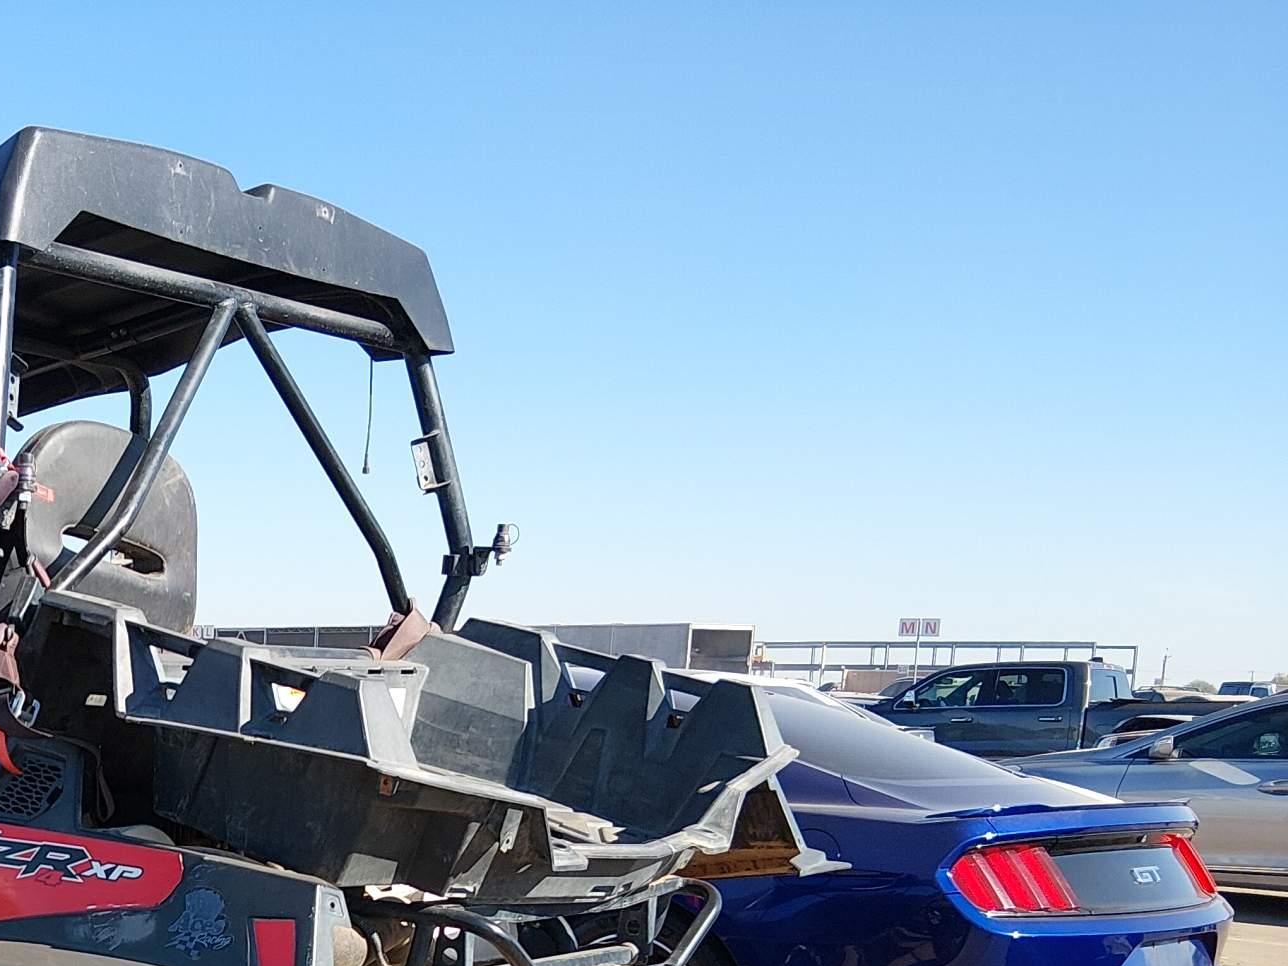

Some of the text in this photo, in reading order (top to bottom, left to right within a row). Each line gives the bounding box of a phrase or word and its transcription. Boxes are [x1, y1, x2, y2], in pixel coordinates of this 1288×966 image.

[901, 621, 937, 634] M N
[82, 859, 145, 881] XP
[1131, 865, 1161, 884] GT
